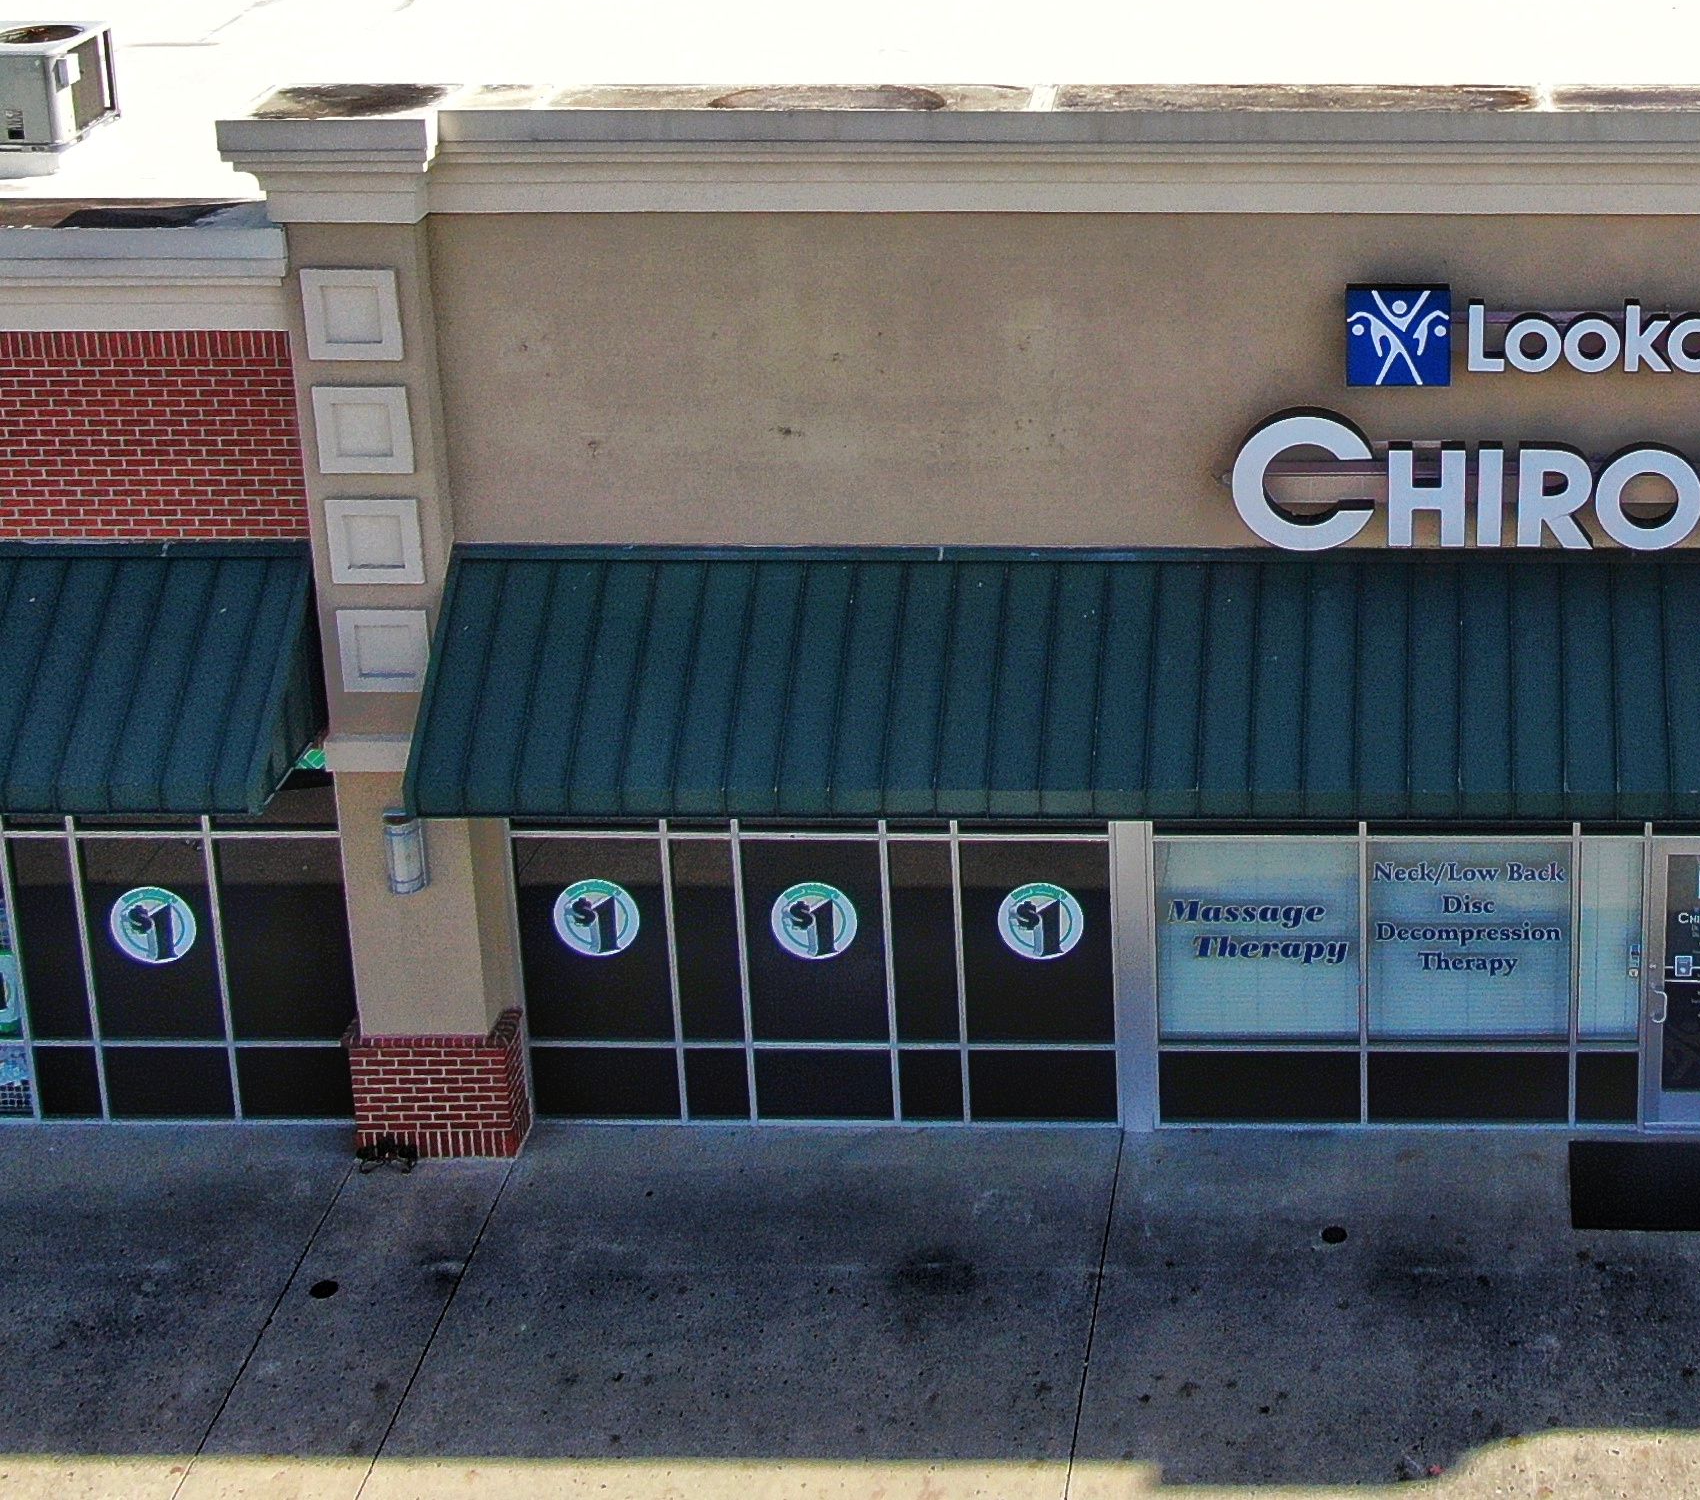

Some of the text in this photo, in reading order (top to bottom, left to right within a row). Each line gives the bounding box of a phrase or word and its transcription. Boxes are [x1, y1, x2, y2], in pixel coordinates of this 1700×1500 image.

[1373, 861, 1565, 886] Neck/Low Back
[1168, 898, 1327, 931] Massage
[1441, 894, 1496, 915] Disc
[1375, 920, 1562, 947] Decompression
[1193, 934, 1350, 966] Therapy
[1417, 950, 1519, 977] Therapy
